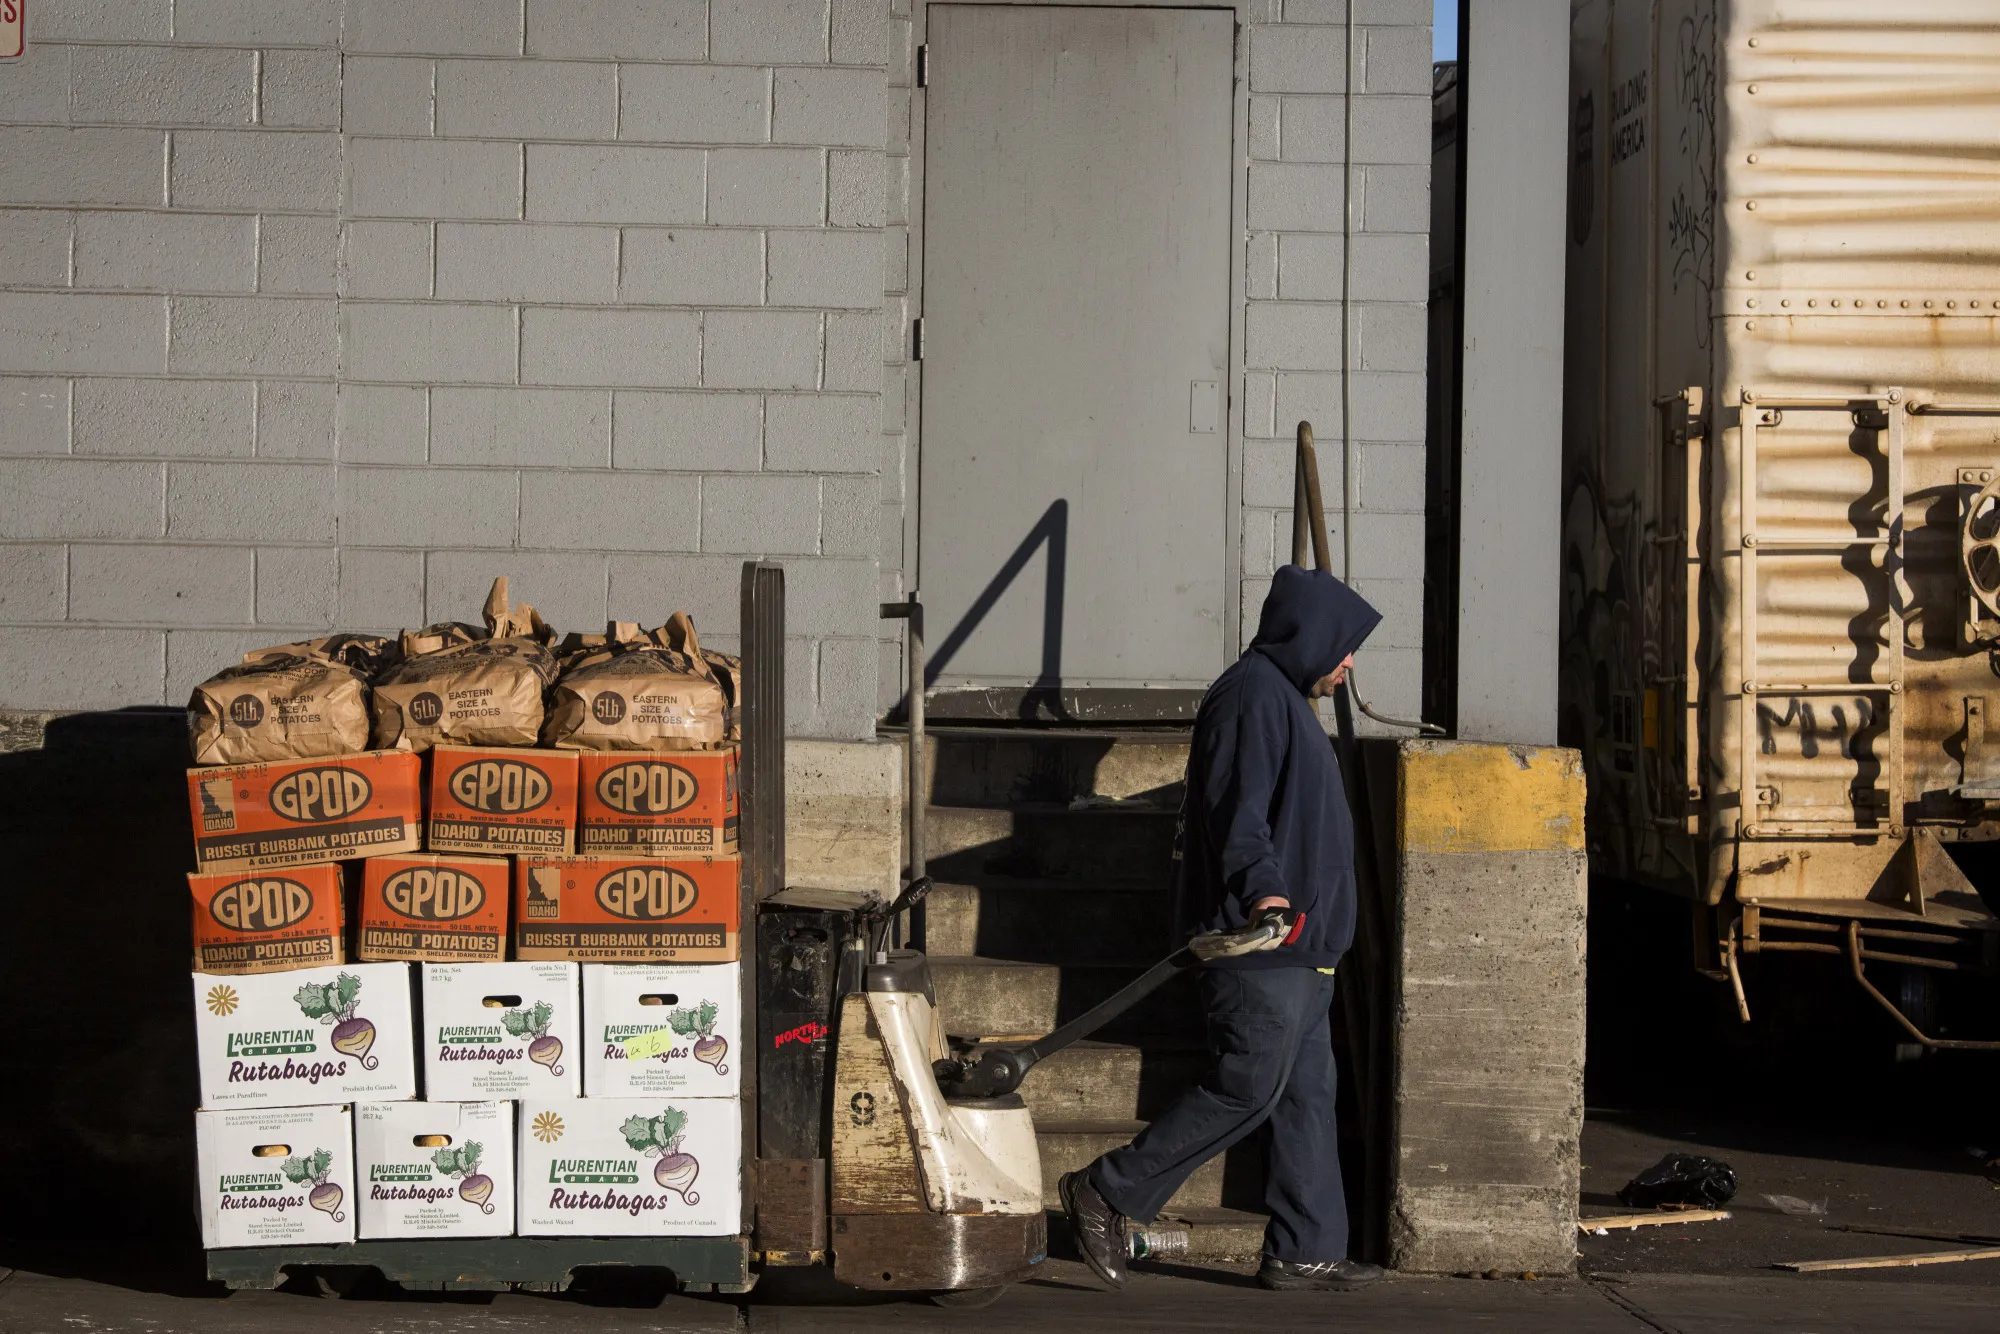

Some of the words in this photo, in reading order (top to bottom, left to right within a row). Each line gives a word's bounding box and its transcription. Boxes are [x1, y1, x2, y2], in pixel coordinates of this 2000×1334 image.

[1611, 69, 1647, 123] BUILDING
[1611, 116, 1645, 167] AMERICA
[270, 695, 314, 705] EASTERN
[448, 688, 493, 700] EASTERN
[632, 695, 678, 704] EASTERN
[278, 706, 298, 714] SIZE
[301, 705, 308, 713] A
[457, 699, 478, 709] SIZE
[640, 705, 661, 714] SIZE
[270, 714, 321, 724] POTATOES
[450, 708, 500, 719] POTATOES
[631, 715, 682, 724] POTATOES
[272, 770, 370, 820] GPOD
[452, 762, 548, 811] GPOD
[599, 764, 695, 812] GPOD
[205, 818, 234, 831] IDAHO
[434, 823, 479, 840] IDAHO
[487, 828, 563, 845] POTATOES
[584, 828, 629, 843] IDAHO
[636, 828, 711, 844] POTATOES
[205, 842, 256, 860] RUSSET
[260, 834, 327, 855] BURBANK
[331, 827, 400, 847] POTATOES
[258, 854, 298, 865] GLUTEN
[299, 851, 326, 861] FREE
[329, 848, 357, 857] FOOD
[385, 870, 482, 917] GPOD
[598, 869, 695, 917] GPOD
[213, 881, 310, 929] GPOD
[528, 906, 557, 917] IDAHO
[367, 931, 412, 947] IDAHO
[421, 934, 496, 950] POTATOES
[526, 933, 576, 946] RUSSET
[580, 933, 648, 947] BURBANK
[652, 933, 721, 946] POTATOES
[203, 947, 247, 962] IDAHO
[255, 940, 330, 959] POTATOES
[262, 959, 291, 967] SHELLEY,
[226, 1029, 314, 1057] LAURENTIAN
[438, 1026, 501, 1044] LAURENTIAN
[247, 1045, 311, 1055] BRAND
[439, 1045, 524, 1065] Rutabagas
[228, 1058, 347, 1085] Rutabagas
[342, 1085, 365, 1093] Produit
[370, 1164, 431, 1182] LAURENTIAN
[549, 1159, 638, 1184] LAURENTIAN
[219, 1173, 281, 1193] LAURENTIAN
[221, 1194, 304, 1212] Rutabagas
[371, 1184, 454, 1204] Rutabagas
[549, 1187, 668, 1217] Rutabagas
